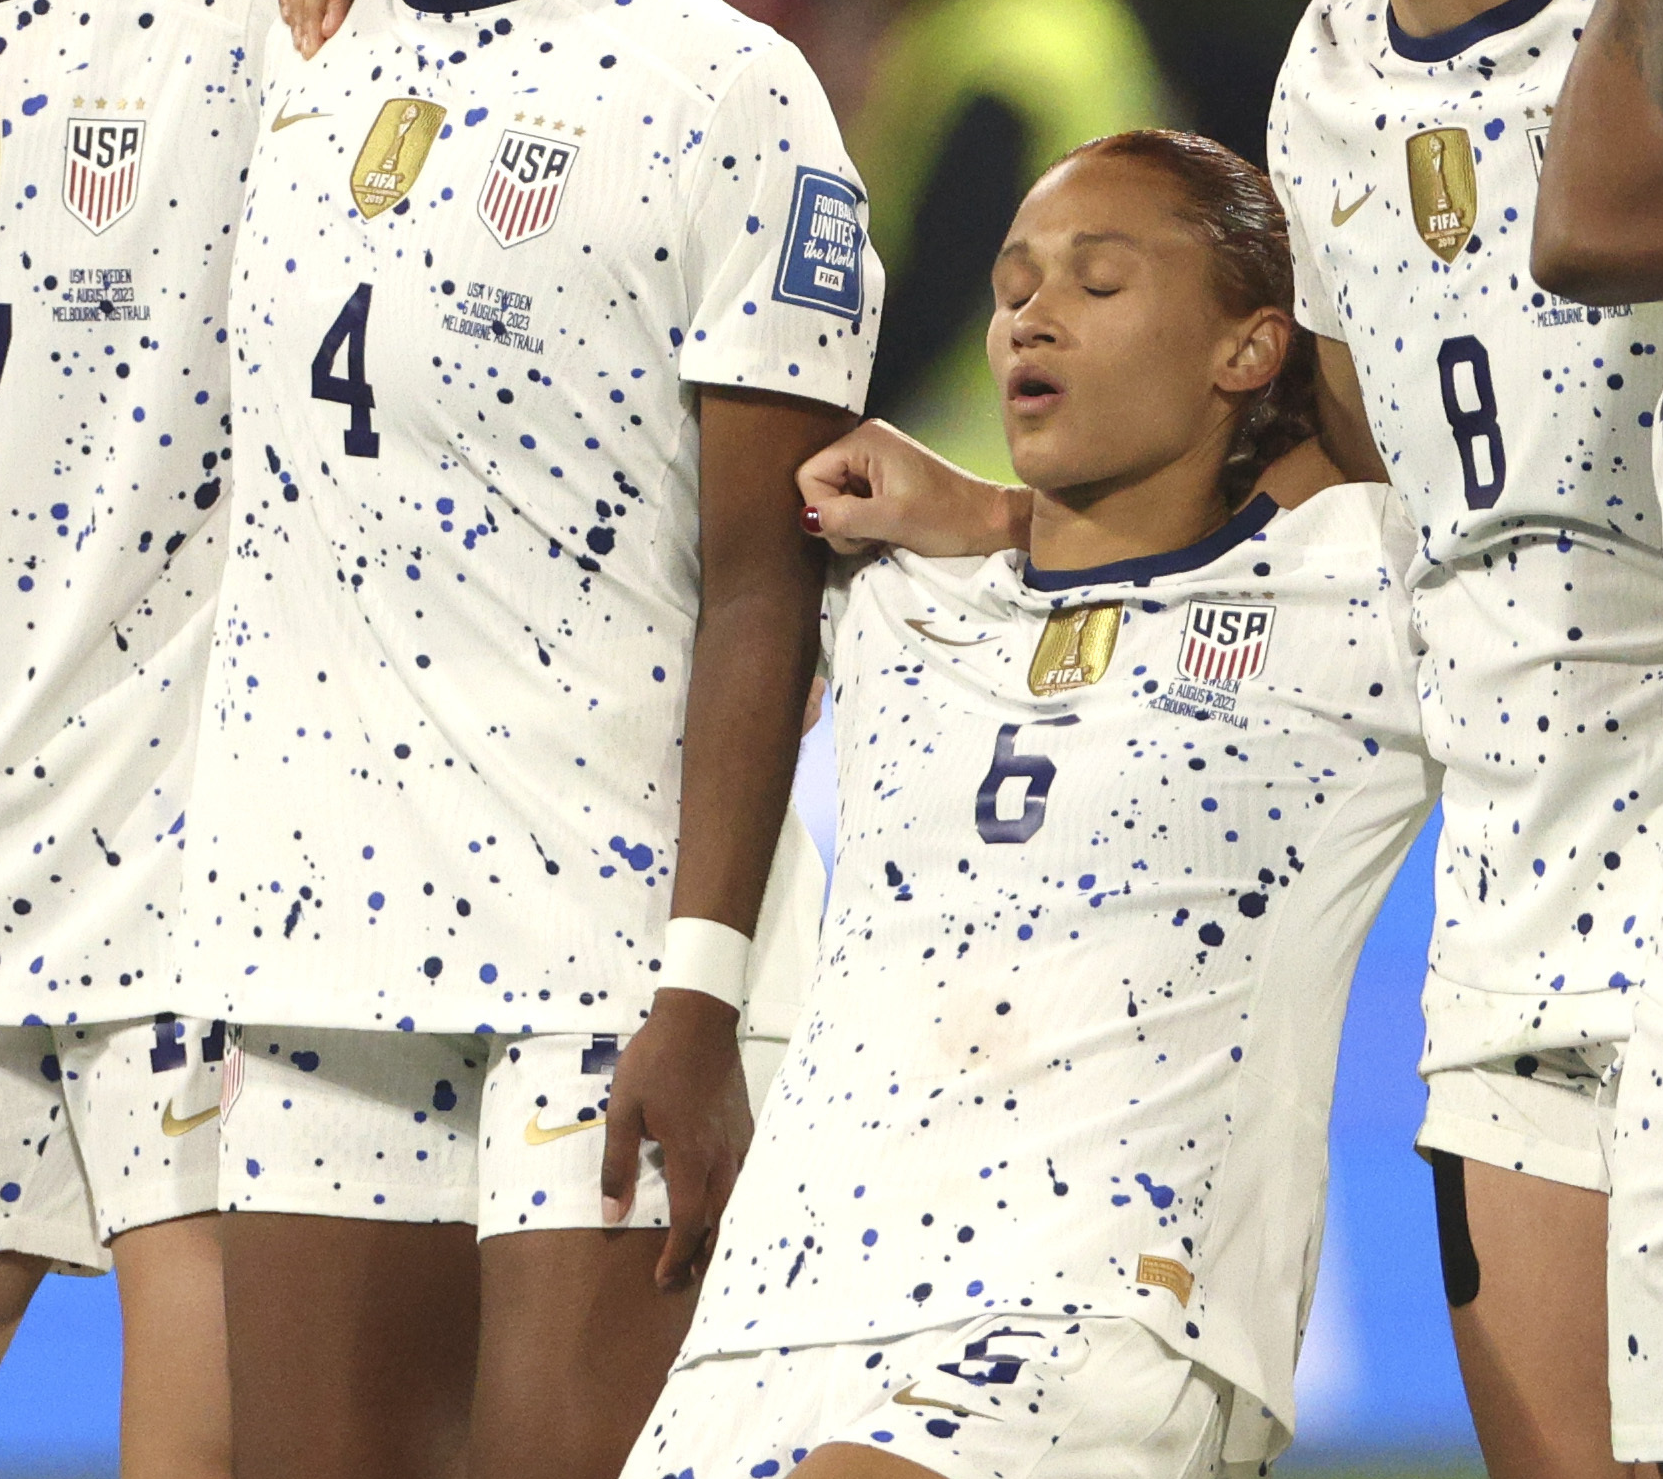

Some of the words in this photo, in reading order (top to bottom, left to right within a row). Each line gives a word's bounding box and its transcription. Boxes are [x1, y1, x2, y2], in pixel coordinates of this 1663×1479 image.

[74, 126, 139, 169] USA
[500, 138, 570, 183] USA
[364, 172, 398, 189] FIFA
[814, 194, 857, 224] FOOTBALL
[1429, 212, 1460, 232] FIFA
[810, 214, 856, 248] UNITES
[803, 238, 825, 260] the
[826, 243, 856, 273] World
[69, 269, 86, 284] USA
[88, 269, 93, 283] V
[96, 268, 132, 284] SWEDEN
[819, 271, 840, 286] FIFA
[68, 288, 74, 302] 6
[76, 287, 109, 302] AUGUST
[112, 288, 134, 302] 2023
[467, 282, 485, 299] USA
[487, 286, 493, 300] V
[495, 288, 532, 311] SWEDEN
[462, 300, 469, 314] 6
[470, 302, 505, 321] AUGUST
[506, 311, 530, 331] 2023
[1587, 302, 1633, 322] STRALIA
[441, 313, 492, 341] MELBOURNE
[493, 326, 544, 355] AUSTRALIA
[311, 282, 380, 458] 4
[1436, 336, 1504, 510] 8
[1193, 607, 1268, 646] USA
[1046, 667, 1083, 684] FIFA
[1168, 683, 1174, 695] 6
[1175, 684, 1211, 705] AUGUST
[1212, 693, 1237, 711] 2023
[1199, 708, 1249, 731] USTRALIA
[975, 714, 1082, 844] 6
